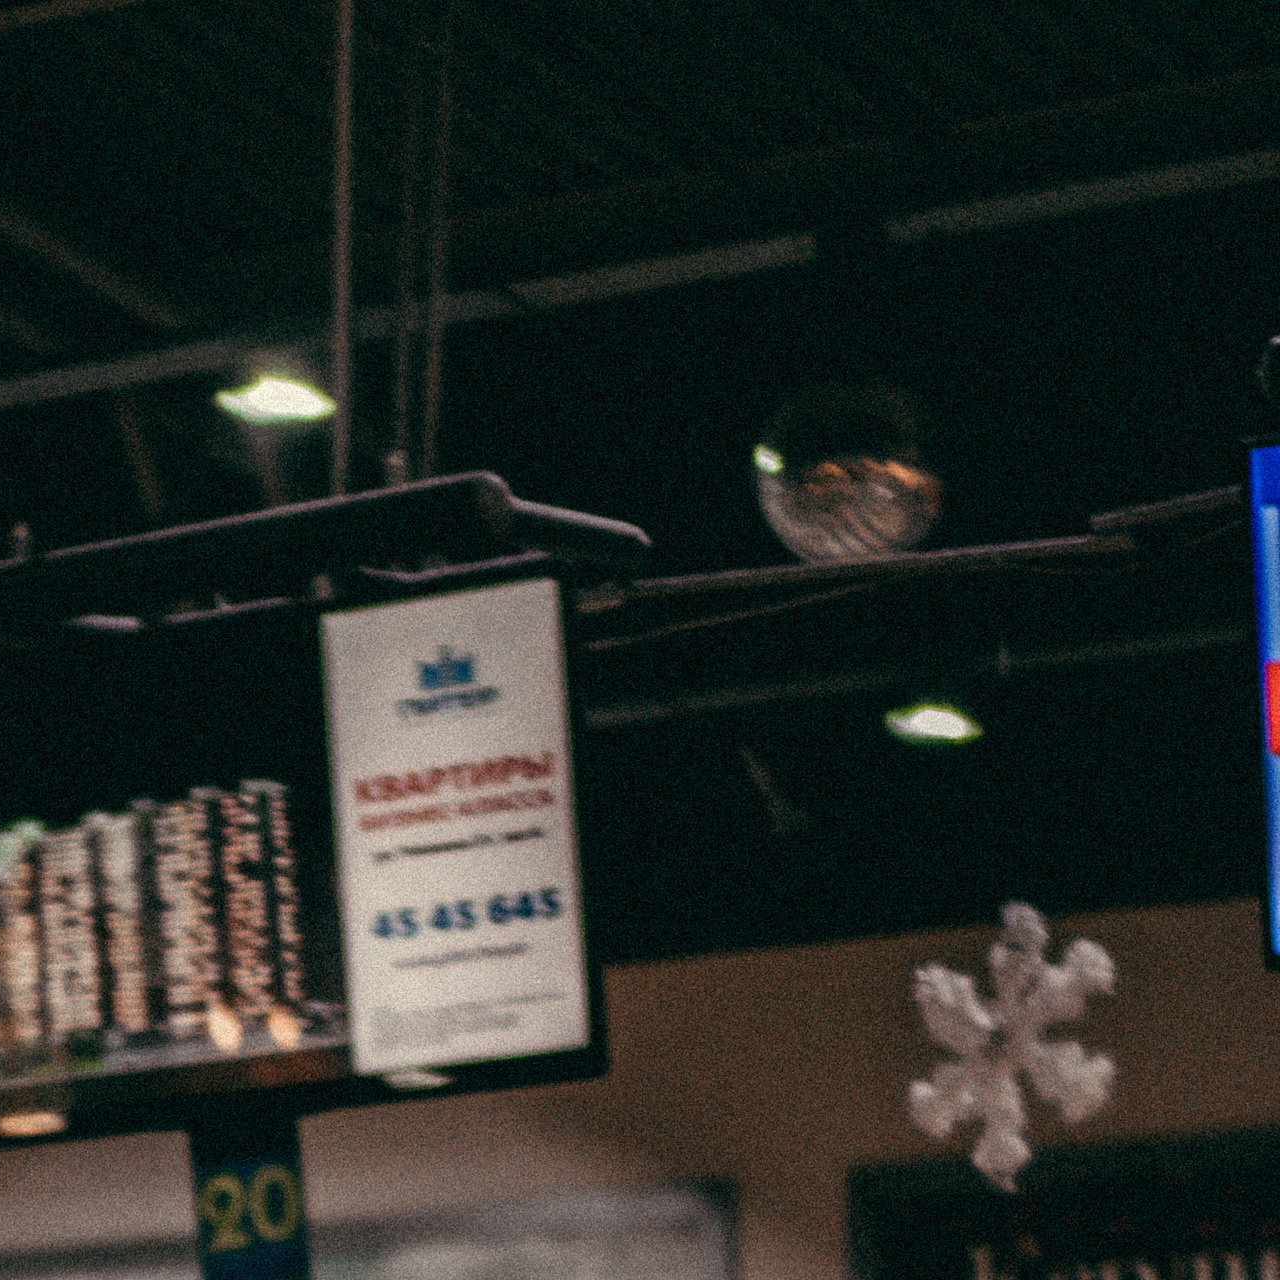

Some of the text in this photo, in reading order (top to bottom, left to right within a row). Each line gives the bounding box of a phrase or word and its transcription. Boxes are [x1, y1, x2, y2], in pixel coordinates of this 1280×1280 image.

[354, 752, 554, 803] КВАРТИРЫ
[372, 887, 562, 939] 45 45 645
[201, 1163, 299, 1252] 20
